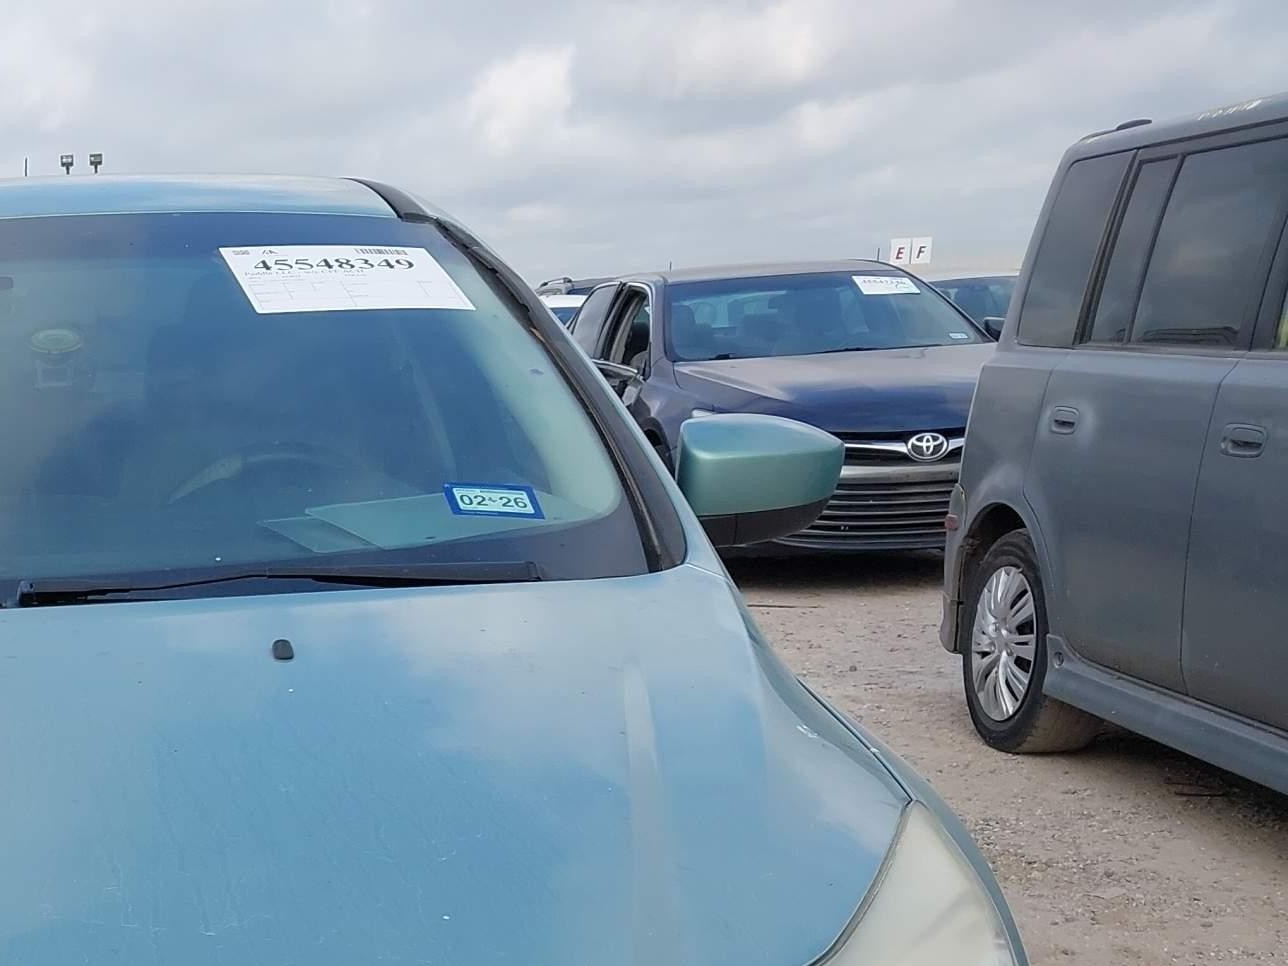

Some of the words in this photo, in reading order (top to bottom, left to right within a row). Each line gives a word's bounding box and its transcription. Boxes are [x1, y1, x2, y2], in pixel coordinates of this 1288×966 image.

[896, 247, 905, 260] E
[916, 246, 927, 259] F
[254, 257, 414, 272] 45548349
